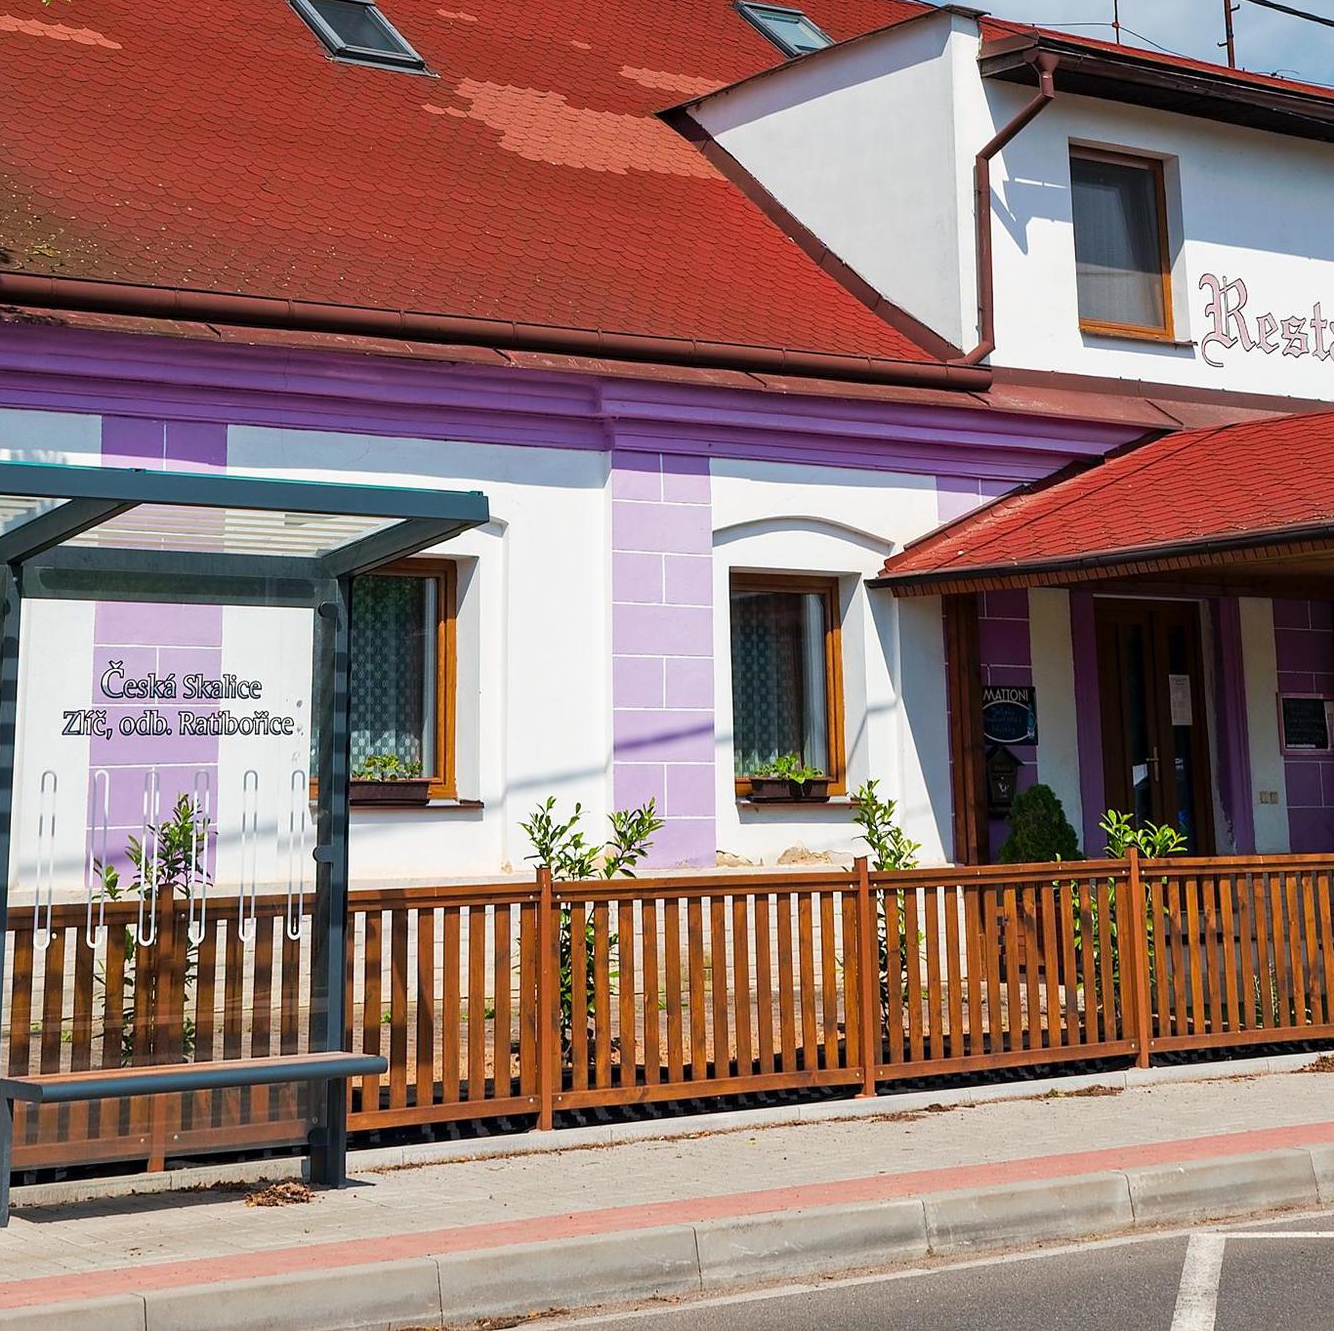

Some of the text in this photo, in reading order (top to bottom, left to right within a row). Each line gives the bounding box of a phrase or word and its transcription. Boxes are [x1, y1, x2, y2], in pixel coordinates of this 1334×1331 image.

[100, 660, 263, 700] Česká Skalice
[982, 689, 1028, 701] MATTONI
[61, 710, 296, 740] Zlíč, odb. Ratibořice
